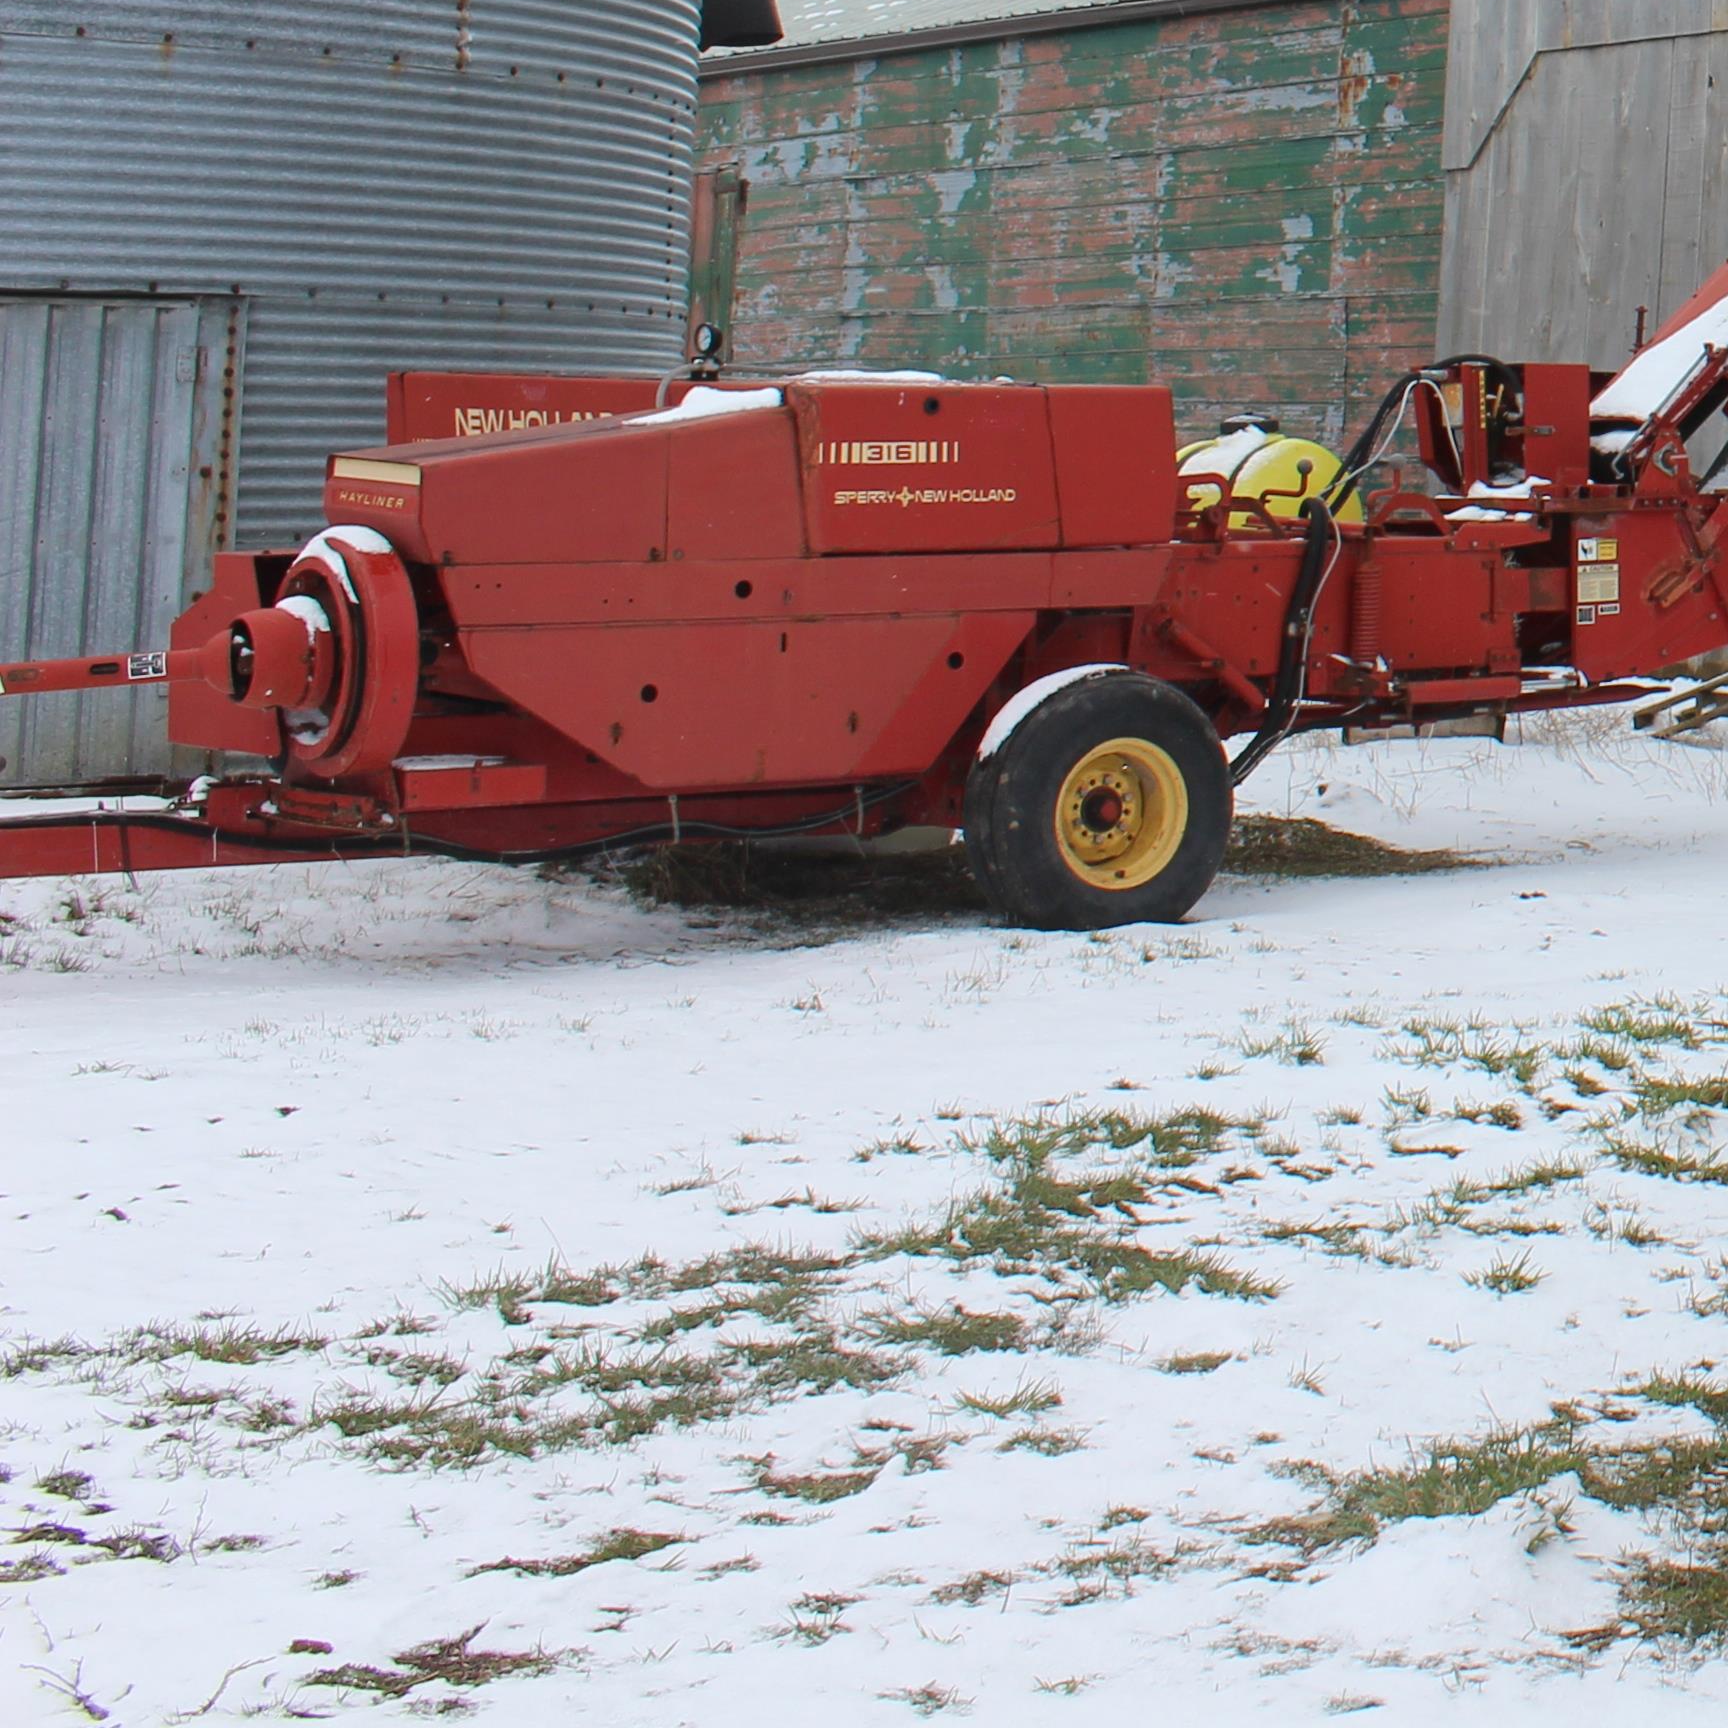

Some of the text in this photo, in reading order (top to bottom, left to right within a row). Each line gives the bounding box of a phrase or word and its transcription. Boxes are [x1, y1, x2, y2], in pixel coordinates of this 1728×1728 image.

[455, 407, 614, 437] NEW HOLL
[339, 490, 405, 509] HAYLINER
[834, 488, 1017, 505] SPERRY NEW HOLLAND
